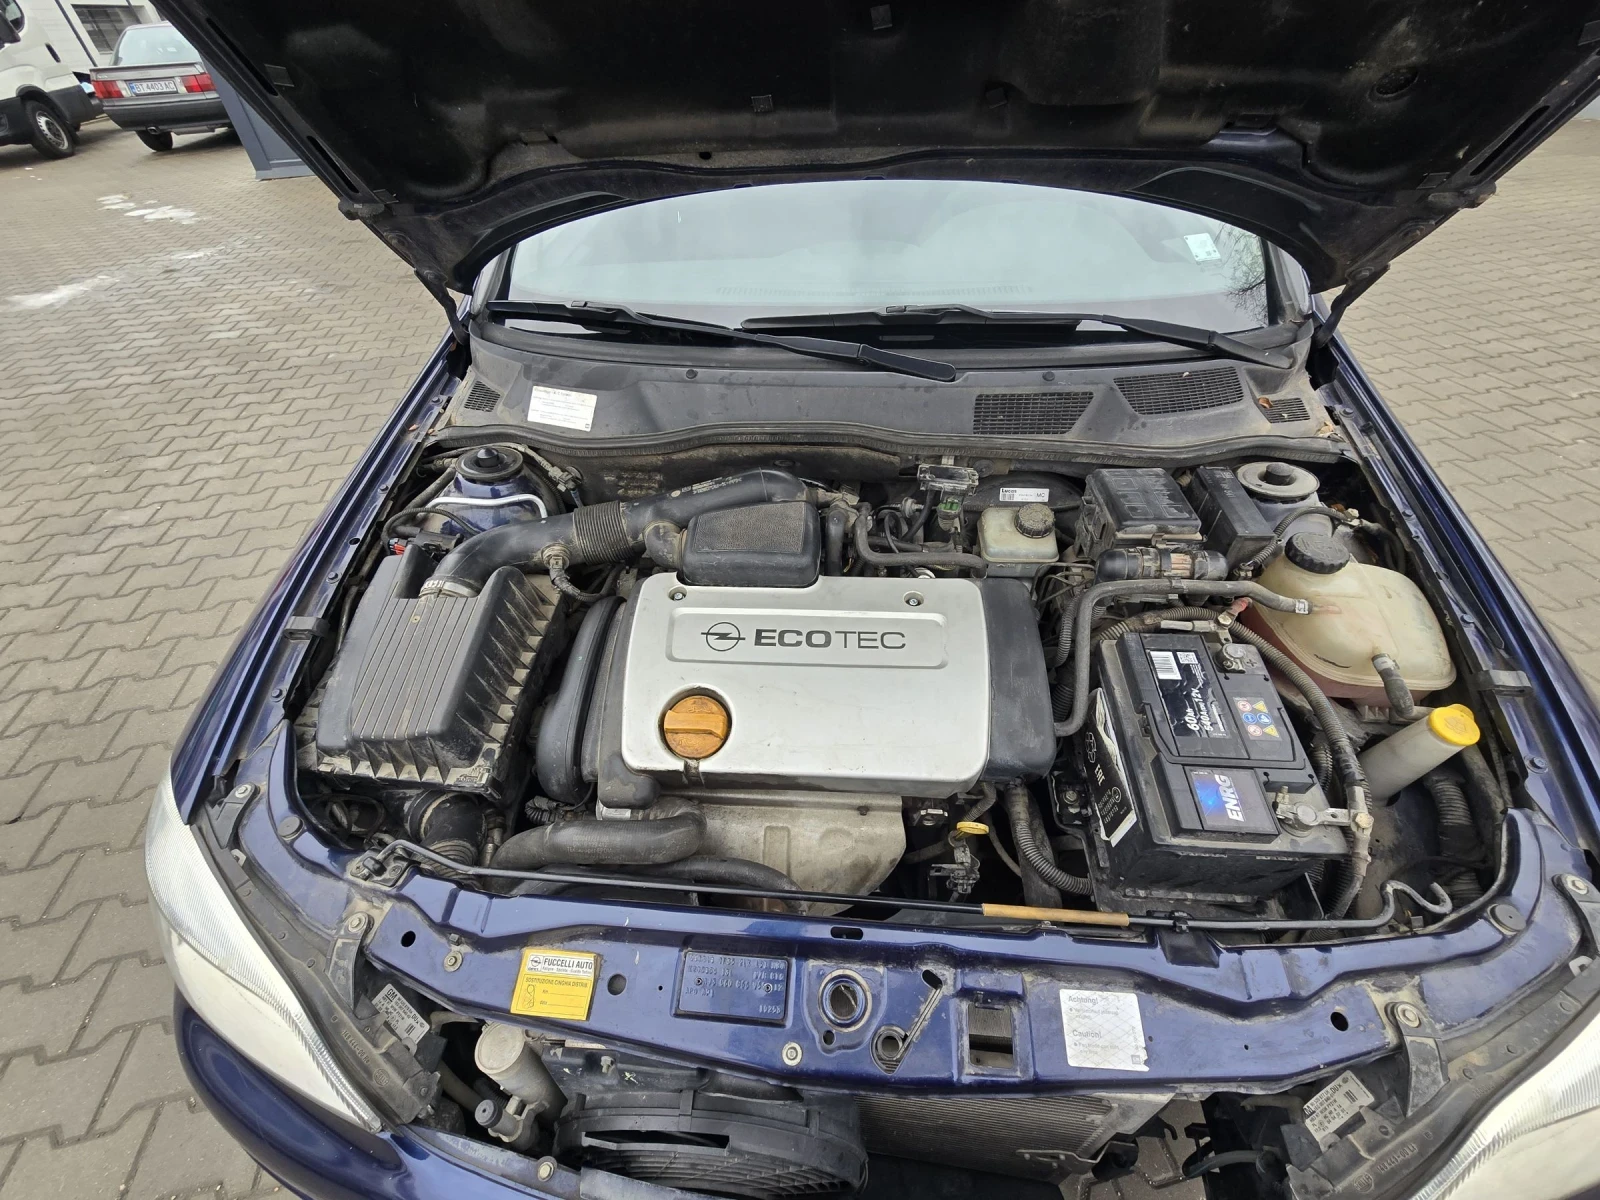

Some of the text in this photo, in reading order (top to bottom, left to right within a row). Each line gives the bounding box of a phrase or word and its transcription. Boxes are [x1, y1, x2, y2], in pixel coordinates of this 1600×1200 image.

[754, 628, 906, 650] ECOTEC
[1214, 774, 1244, 822] ENRG
[543, 958, 593, 970] FUCCELLI AUTO
[386, 988, 397, 999] GM
